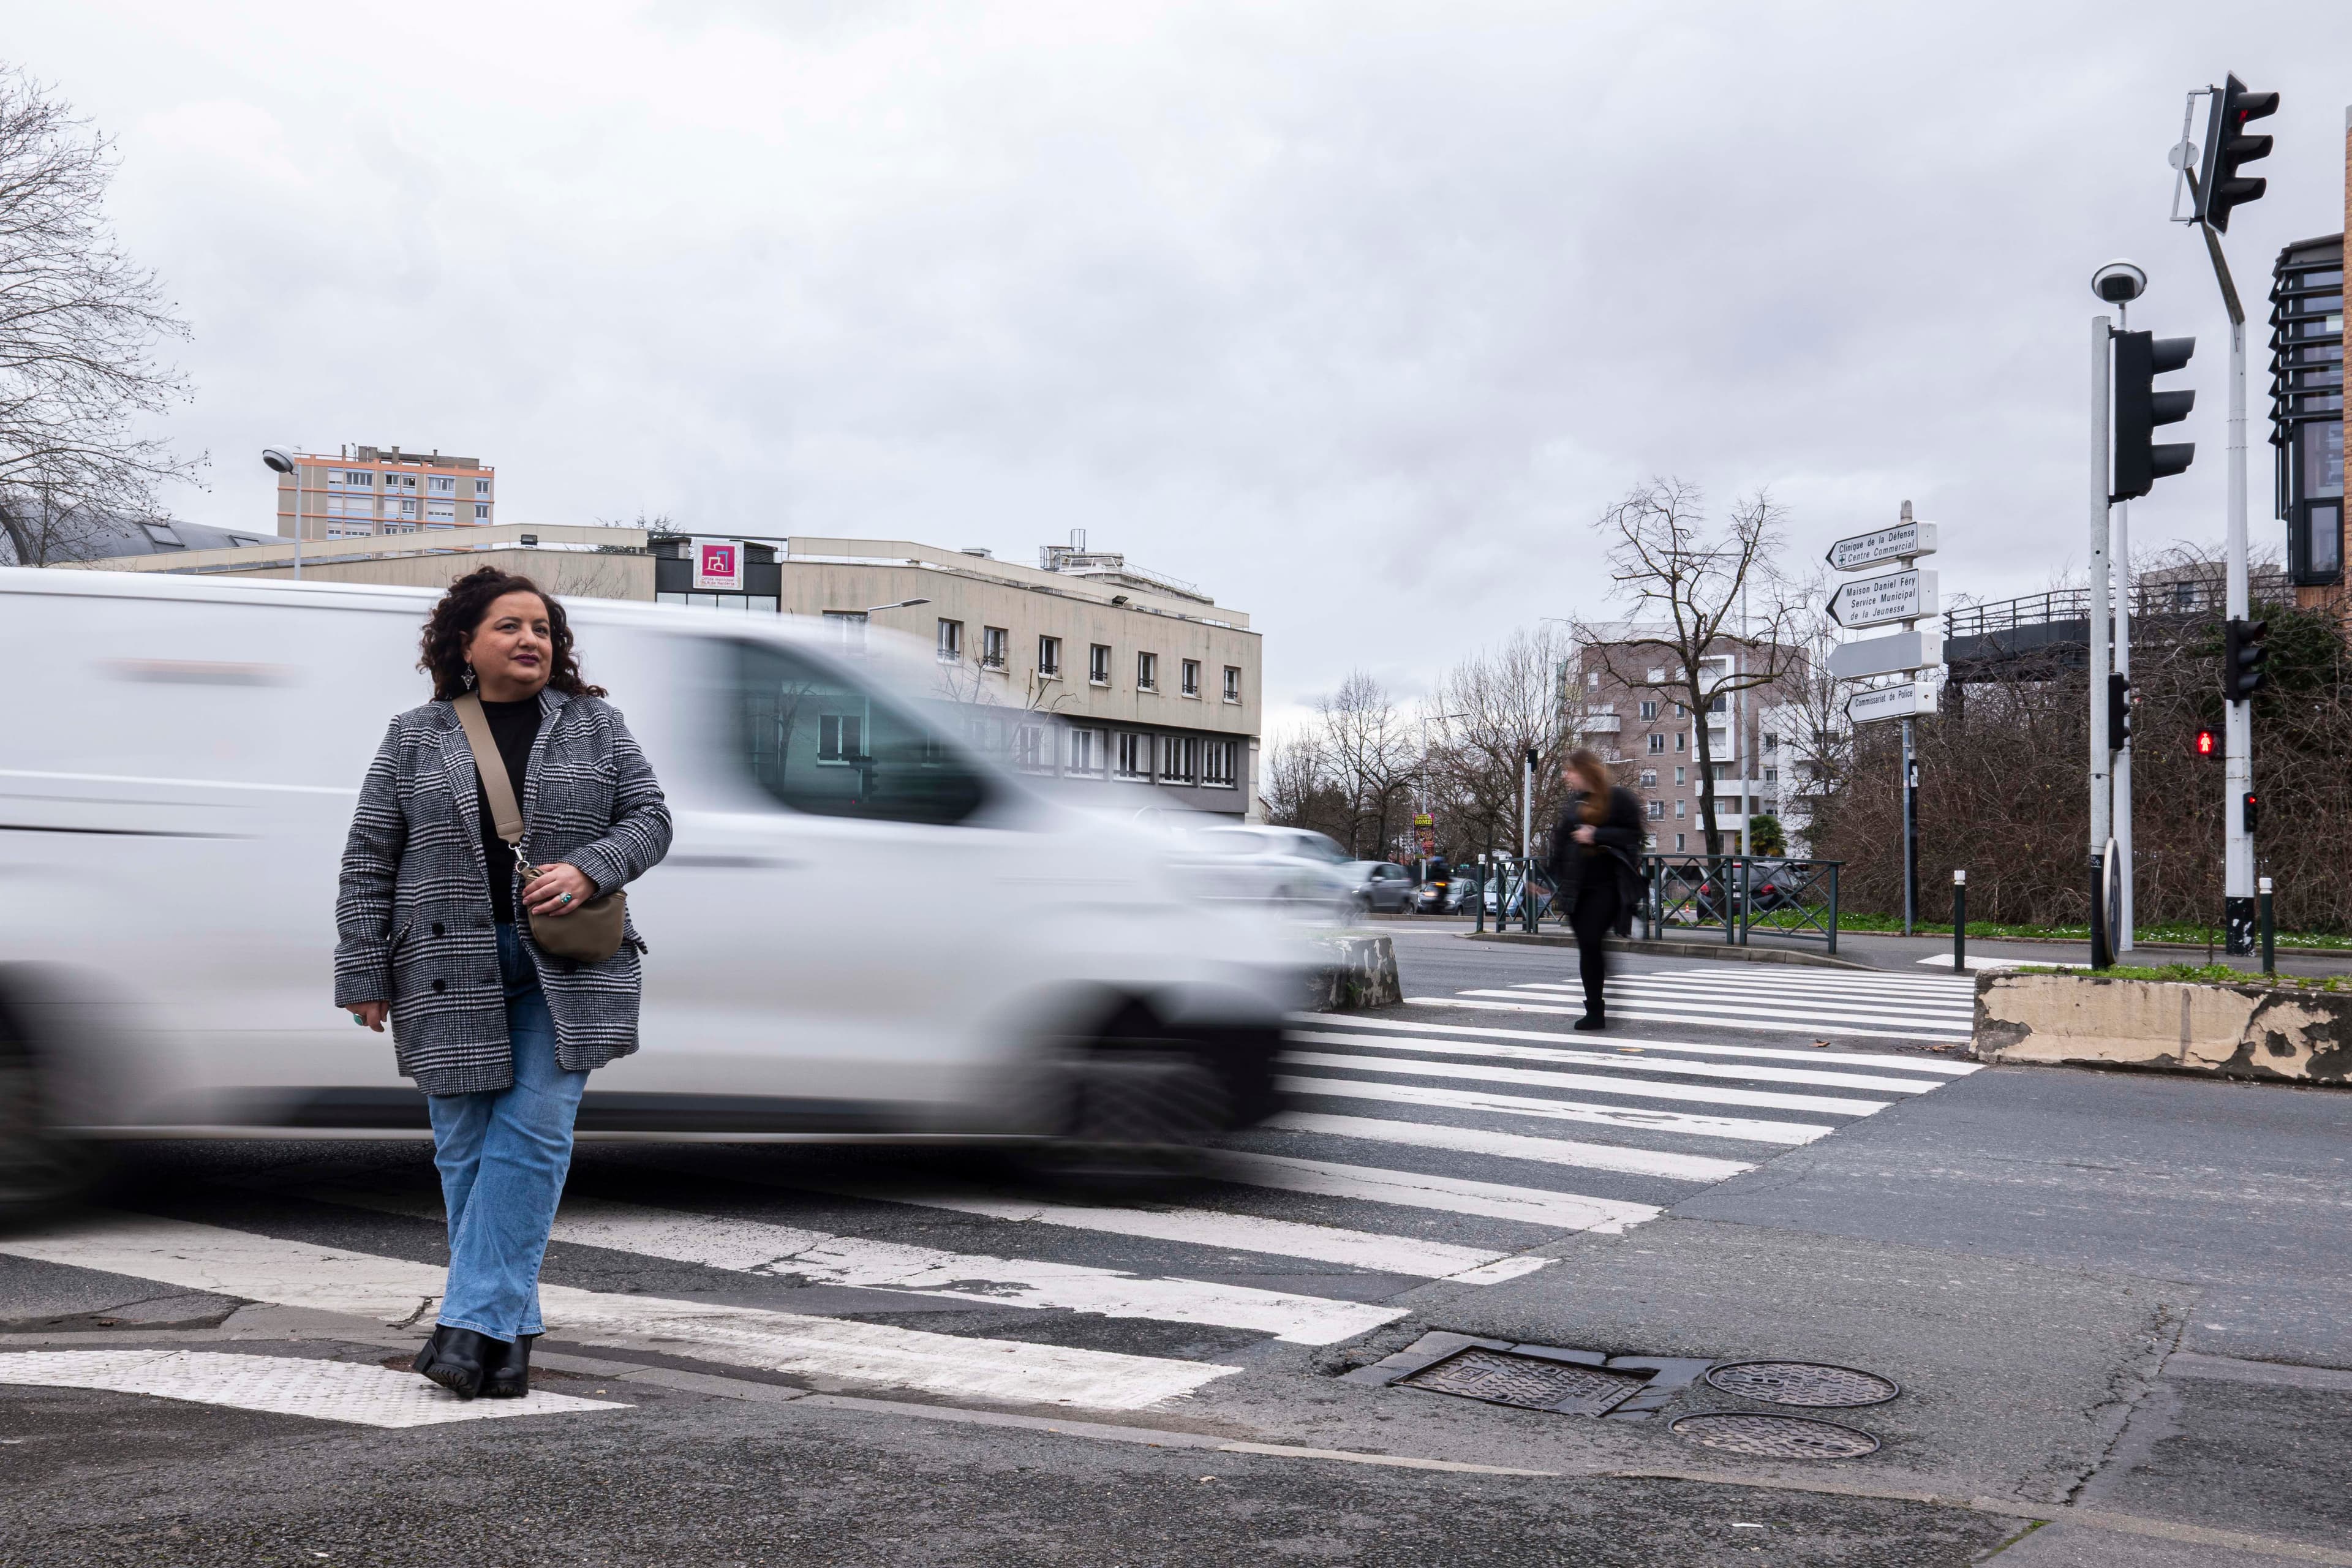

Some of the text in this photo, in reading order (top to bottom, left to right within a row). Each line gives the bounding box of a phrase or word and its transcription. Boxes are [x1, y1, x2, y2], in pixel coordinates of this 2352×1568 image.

[1839, 529, 1915, 553] Clinique de la Défense
[1848, 539, 1915, 562] Centre Commercial
[1847, 576, 1915, 597] Maison Daniel Féry
[1851, 588, 1915, 608] Service Municipal
[1862, 610, 1868, 619] la
[1872, 605, 1905, 617] Jeunesse
[1855, 689, 1913, 707] Commissariat de Police
